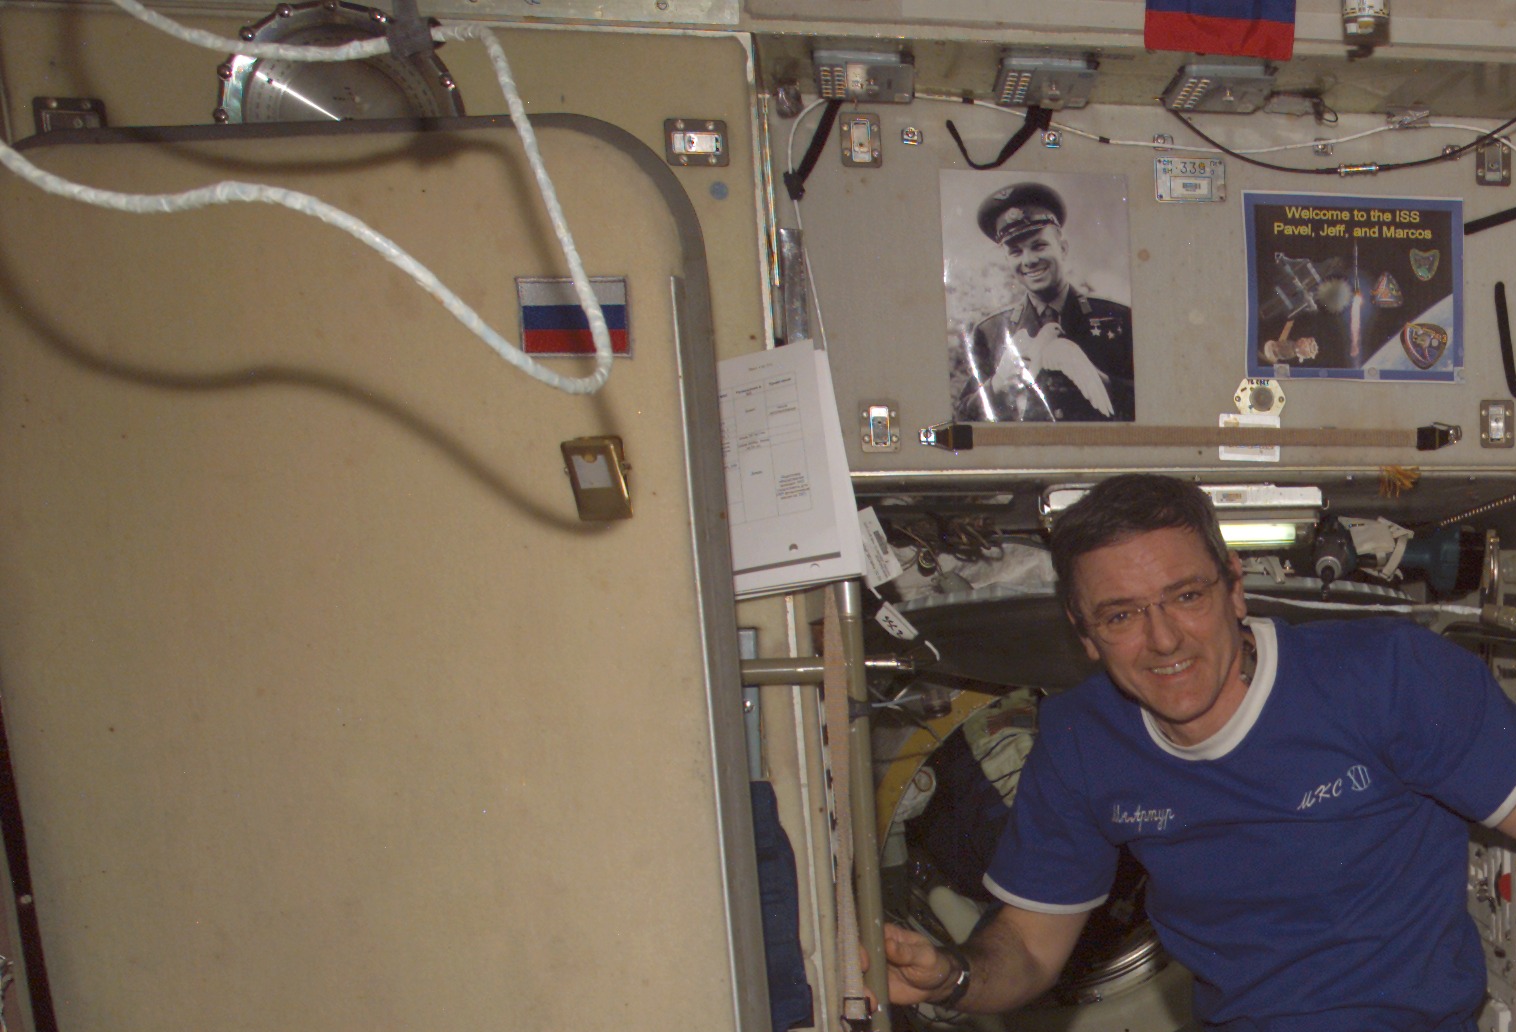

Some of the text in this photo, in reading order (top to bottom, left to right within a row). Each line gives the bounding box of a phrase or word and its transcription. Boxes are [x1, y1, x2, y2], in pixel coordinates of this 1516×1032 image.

[1285, 206, 1420, 223] Welcome to the ISS
[1274, 222, 1432, 240] Pavel, Jeff, and Marcos
